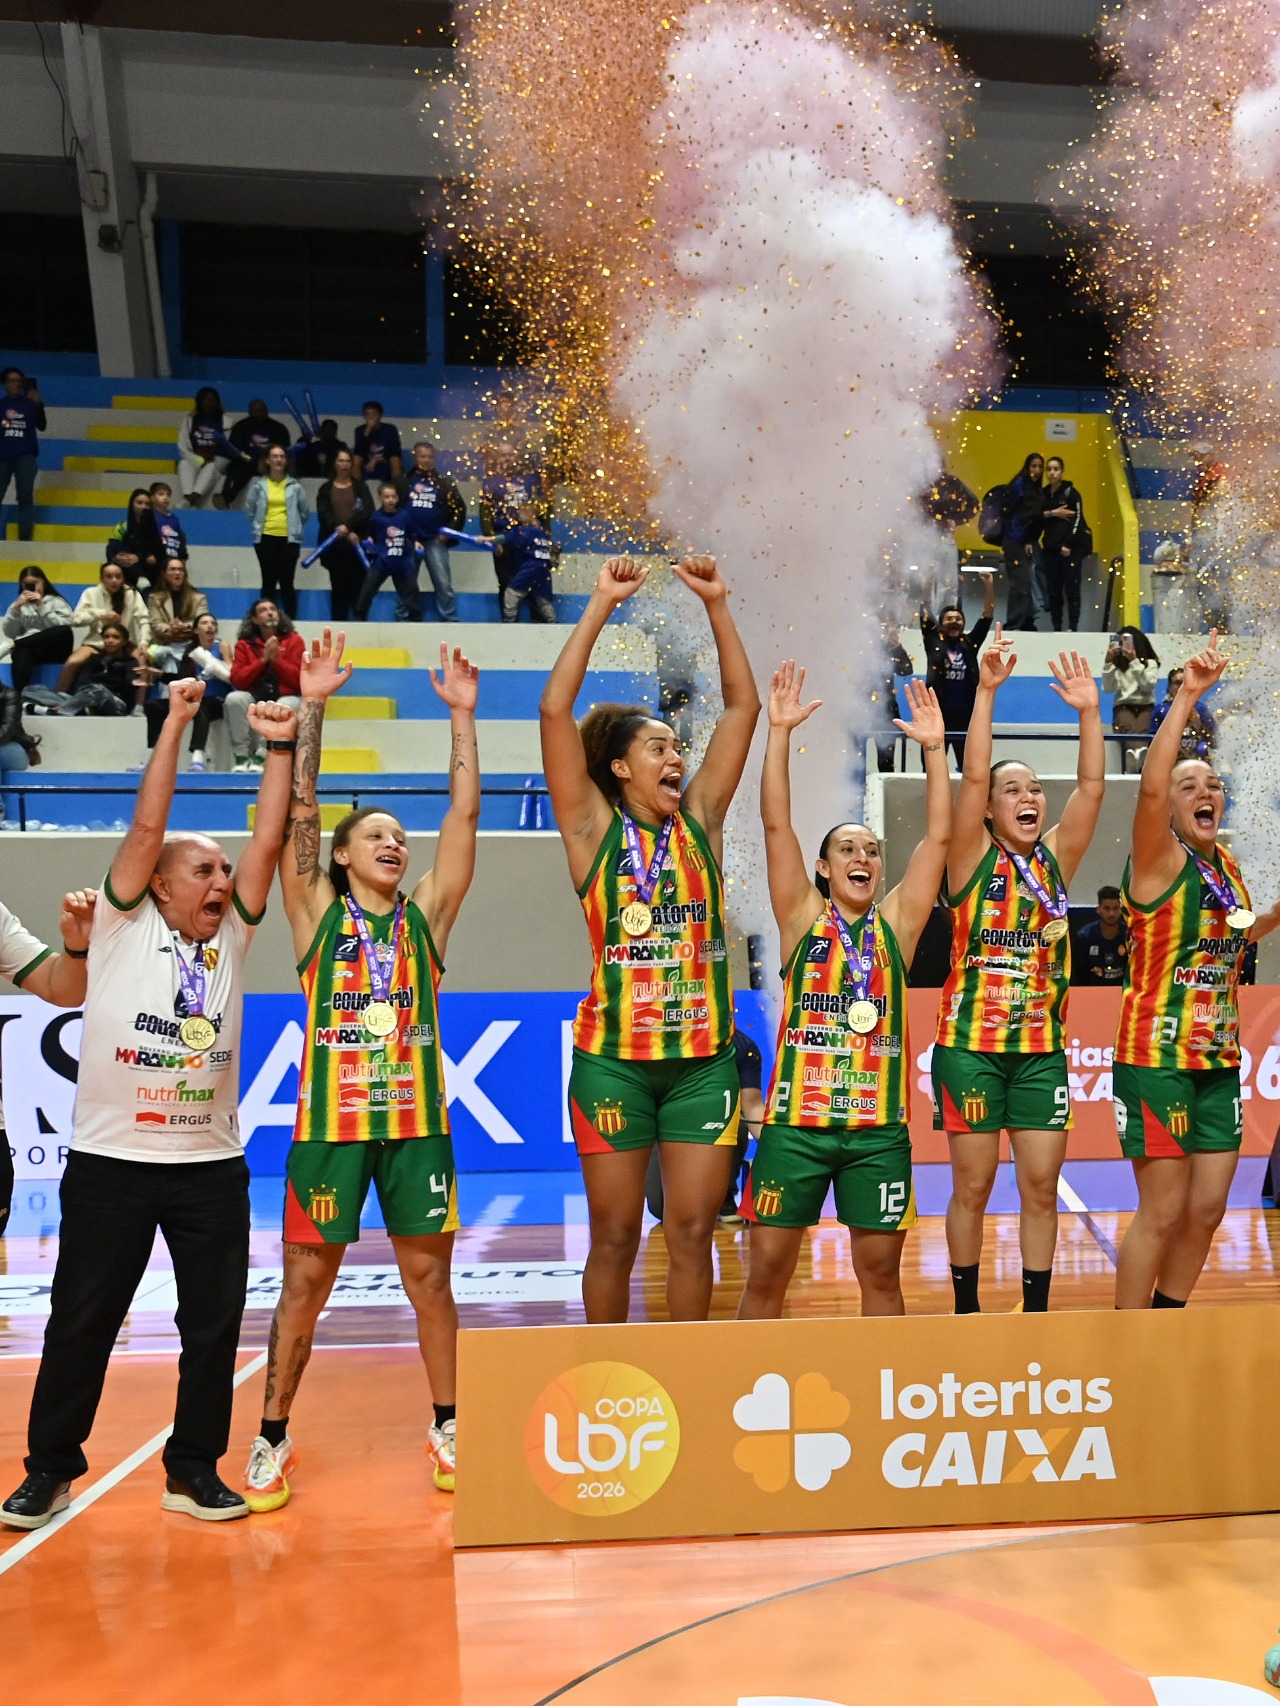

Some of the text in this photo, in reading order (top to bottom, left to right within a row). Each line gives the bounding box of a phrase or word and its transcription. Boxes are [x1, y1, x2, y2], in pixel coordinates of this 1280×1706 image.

[633, 979, 705, 996] nutrimax
[667, 1007, 707, 1020] ERGUS
[1012, 1009, 1046, 1021] ERGUS
[1151, 1016, 1178, 1044] 13
[871, 1035, 900, 1047] SEDEL
[804, 1066, 878, 1084] nutrimax
[372, 1088, 414, 1100] ERGUS
[834, 1096, 876, 1109] ERGUS
[1054, 1086, 1069, 1116] 9
[723, 1089, 731, 1119] 1
[170, 1114, 212, 1125] ERGUS
[429, 1172, 448, 1203] 4
[878, 1181, 905, 1213] 12
[880, 1361, 1113, 1421] loterias
[595, 1396, 664, 1420] COPA
[881, 1425, 1117, 1489] CAIXA
[576, 1482, 626, 1498] 2026
